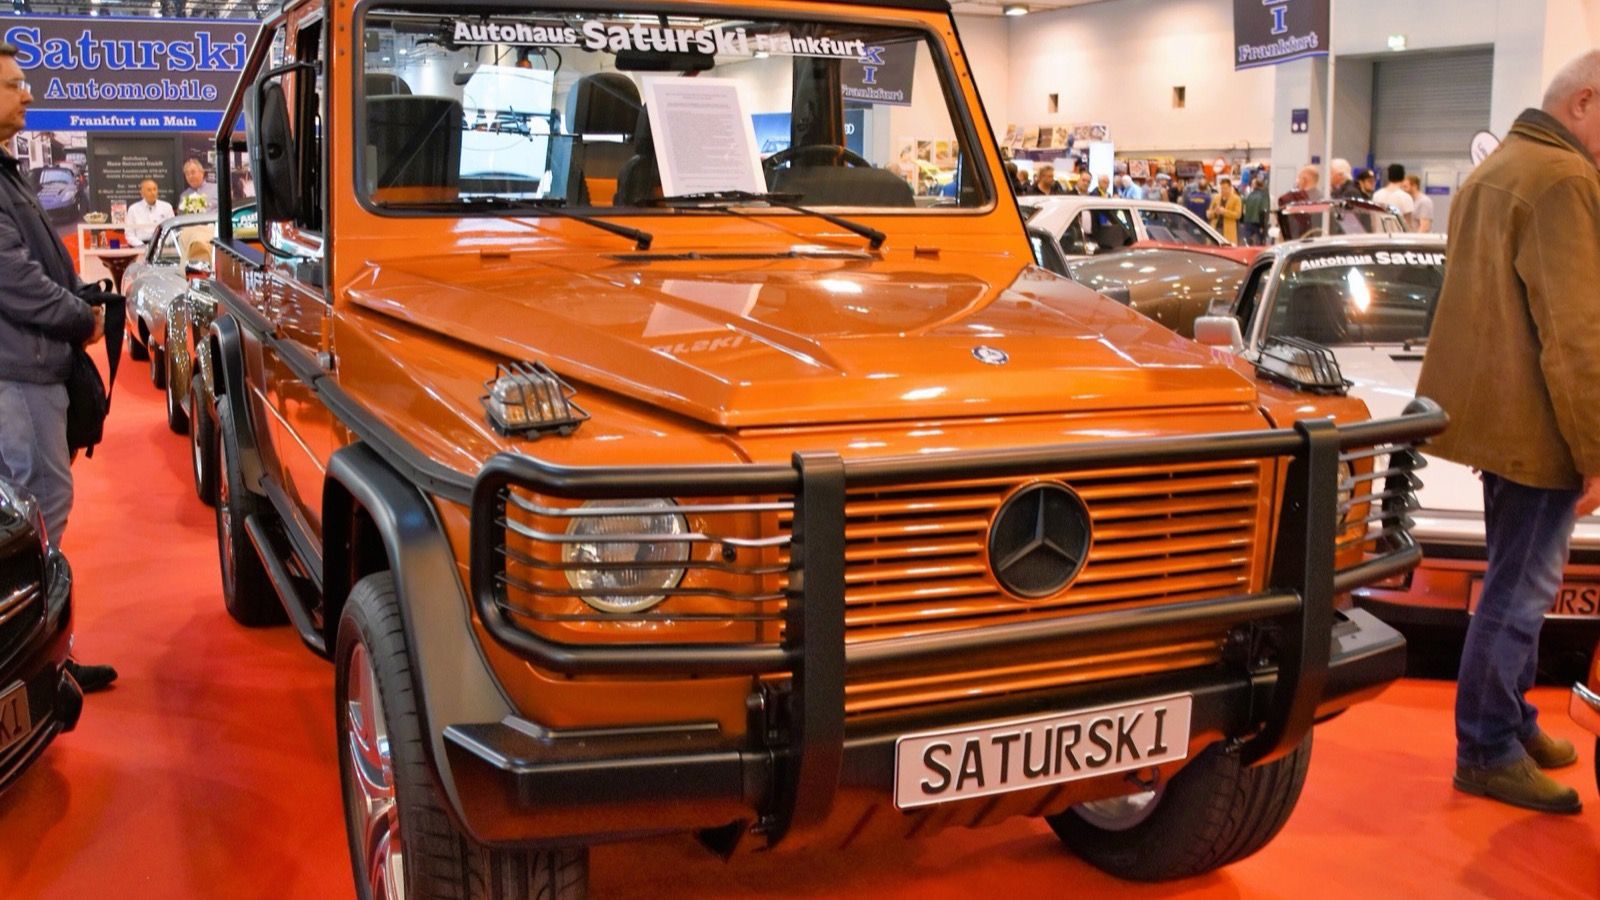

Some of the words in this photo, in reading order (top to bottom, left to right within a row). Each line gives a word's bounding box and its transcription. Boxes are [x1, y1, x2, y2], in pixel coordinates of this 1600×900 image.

[4, 26, 247, 72] Saturski
[453, 20, 577, 43] Autohaus
[582, 19, 749, 56] Saturski
[755, 34, 866, 56] Frankfurt
[1238, 31, 1319, 62] Frankfurt
[44, 77, 218, 101] Automobile
[70, 115, 136, 127] Frankfurt
[139, 118, 159, 127] am
[164, 116, 197, 127] Main
[920, 708, 1168, 796] SATURSKI
